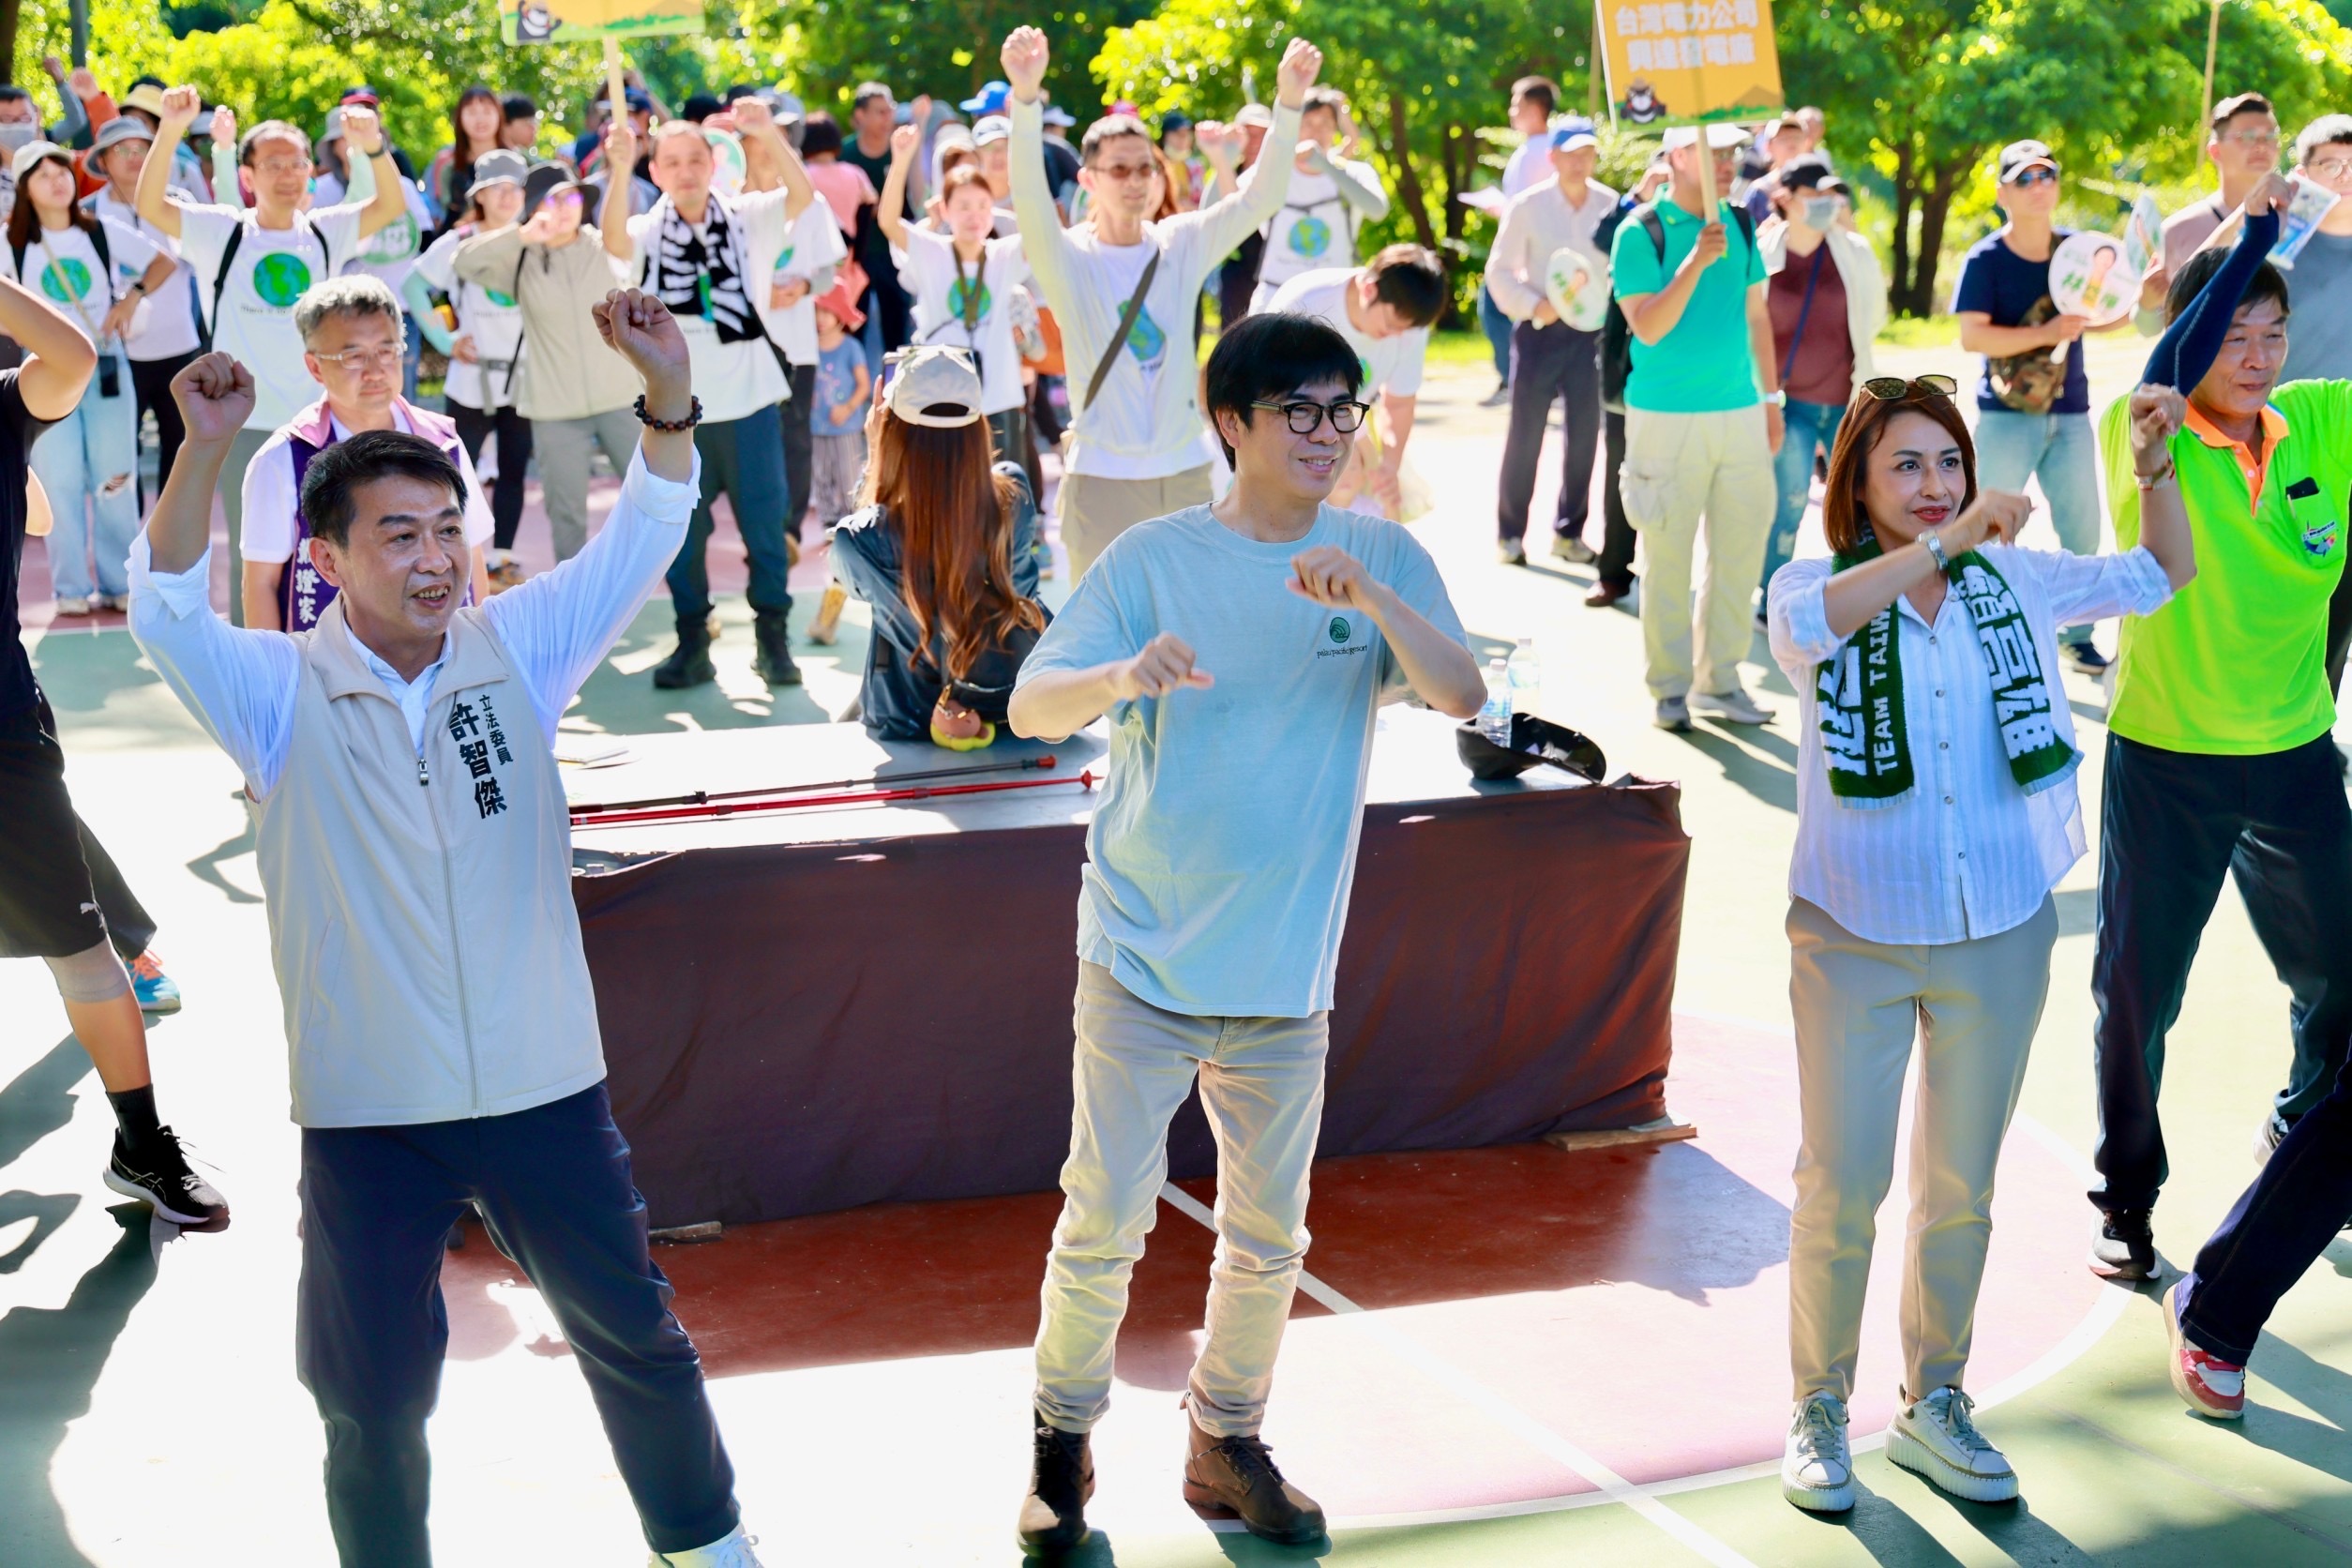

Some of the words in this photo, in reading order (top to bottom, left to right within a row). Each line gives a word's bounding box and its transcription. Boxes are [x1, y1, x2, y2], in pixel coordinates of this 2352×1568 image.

[1615, 0, 1758, 36] 台灣電力公司
[1869, 603, 1892, 686] TAIW
[448, 702, 507, 820] 許智傑
[478, 694, 513, 766] 立法委員
[1873, 695, 1898, 776] TEAM
